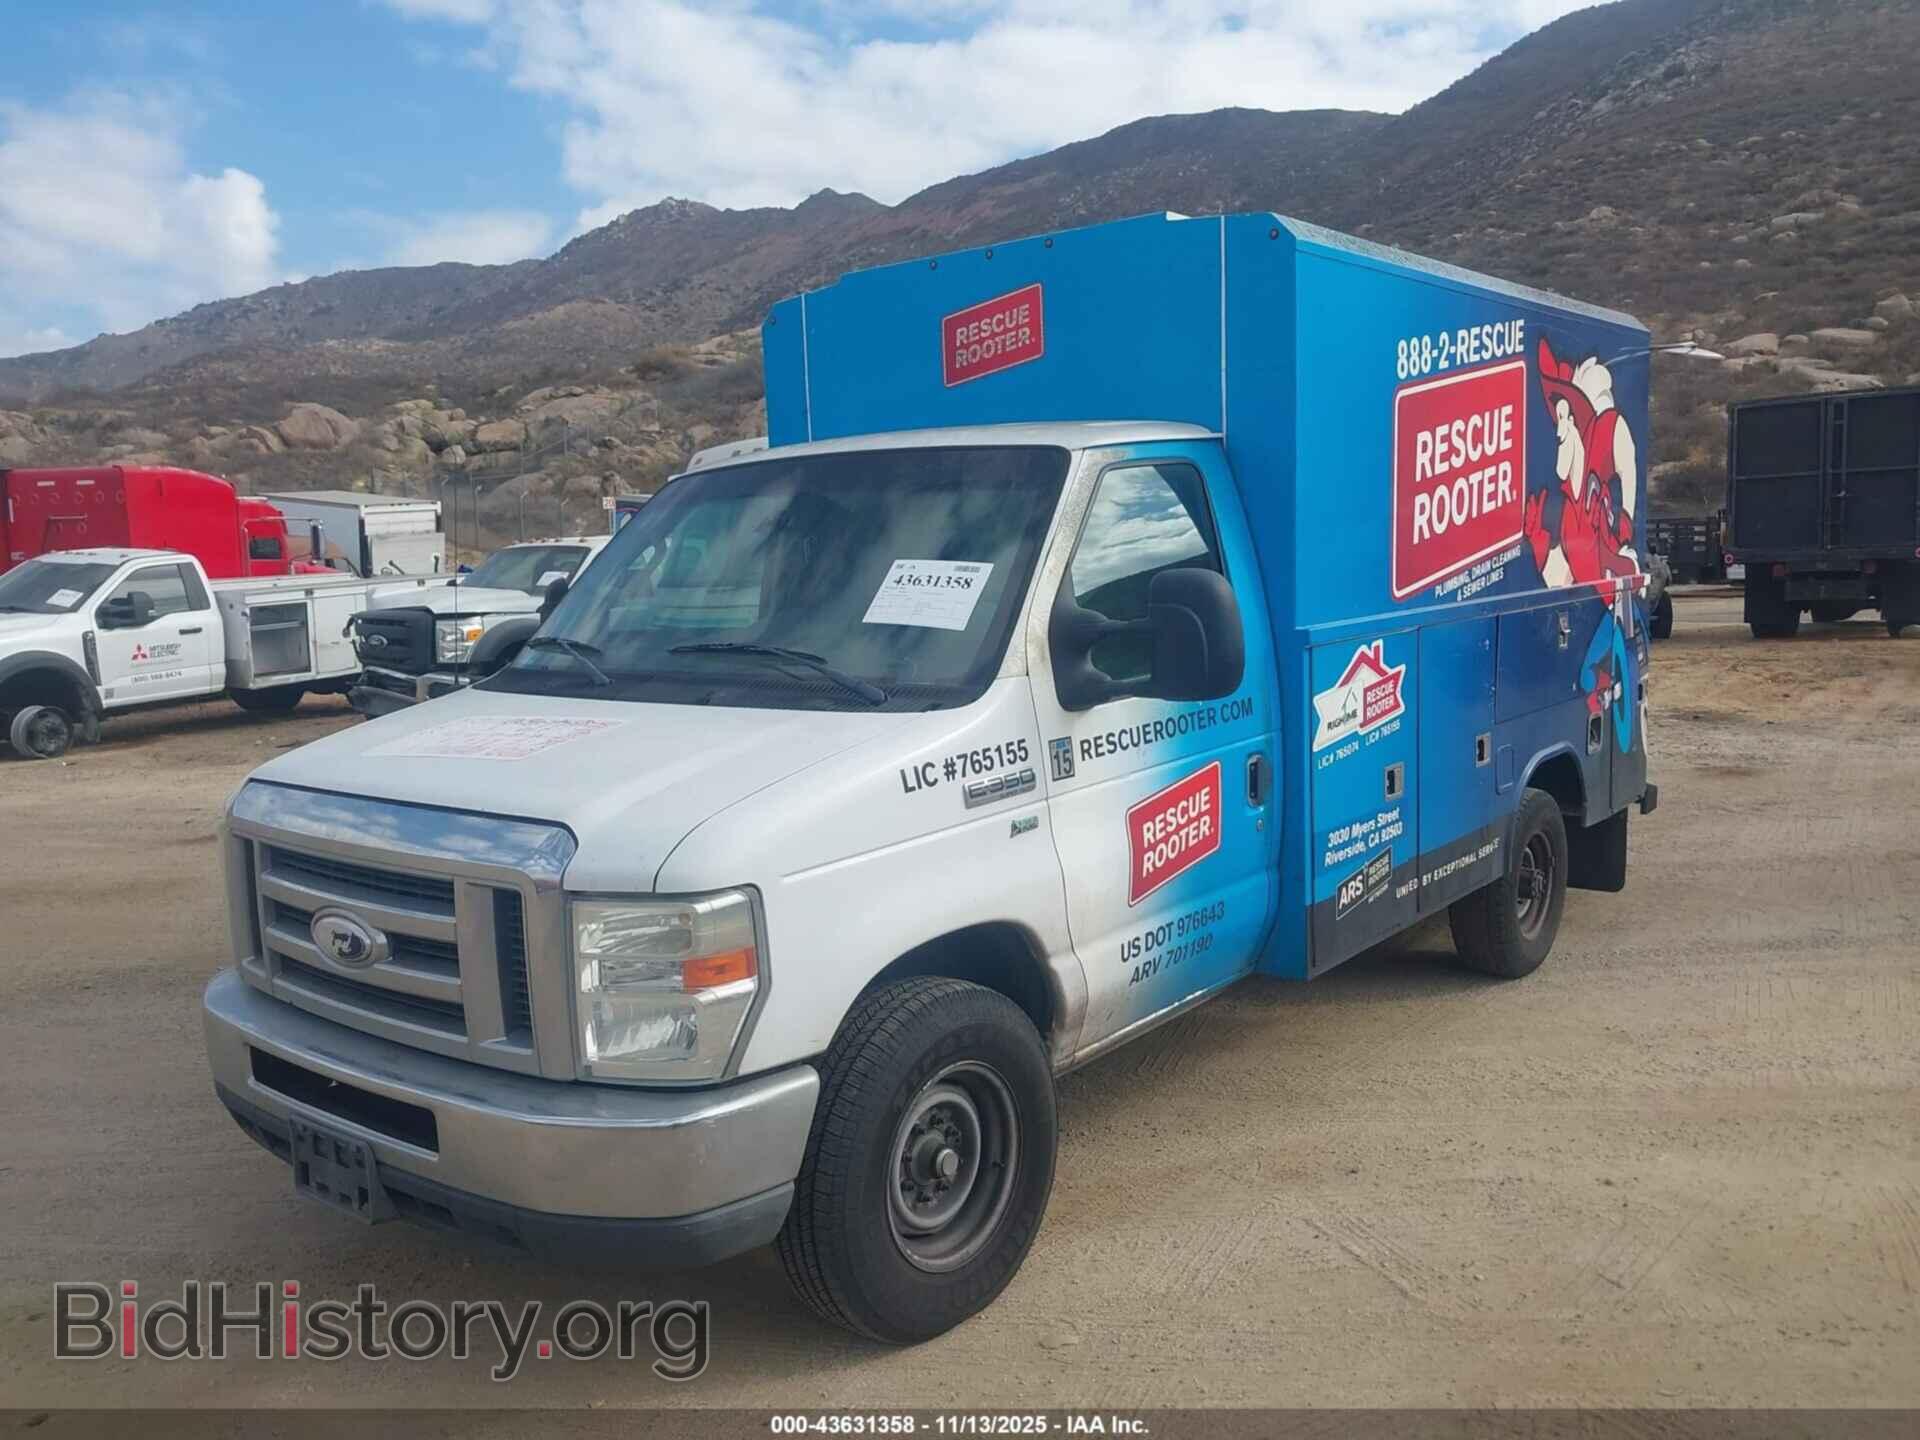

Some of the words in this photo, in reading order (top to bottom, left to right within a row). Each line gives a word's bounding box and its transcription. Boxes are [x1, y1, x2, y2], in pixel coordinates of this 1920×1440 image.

[956, 304, 1030, 346] RESCUE
[1396, 319, 1525, 380] 888-2-RESCUE
[1416, 404, 1513, 482] RESCUE
[893, 574, 974, 589] 43631358
[1435, 570, 1471, 599] PLUMBING,
[1471, 560, 1491, 580] DRAIN
[1491, 544, 1521, 569] CLEANING
[1463, 576, 1486, 598] SEWER
[1486, 567, 1504, 586] LINES
[1366, 680, 1395, 704] RESCUE
[1366, 695, 1395, 720] ROOTER
[900, 761, 938, 793] LIC
[943, 738, 1029, 783] #765155
[1053, 749, 1072, 776] 15
[1142, 786, 1211, 848] RESCUE
[1327, 826, 1351, 848] 3030
[1351, 819, 1376, 839] Myers
[1377, 807, 1400, 828] Street
[1325, 840, 1367, 867] Riverside,
[1368, 832, 1380, 848] CA
[1422, 872, 1433, 887] BY
[1433, 851, 1477, 881] EXCEPTIONAL
[1339, 875, 1364, 909] ARS
[1121, 936, 1141, 963] US
[1145, 922, 1175, 953] DOT
[1176, 901, 1225, 938] 976643
[1129, 955, 1162, 986] ARV
[1164, 933, 1214, 969] 701190
